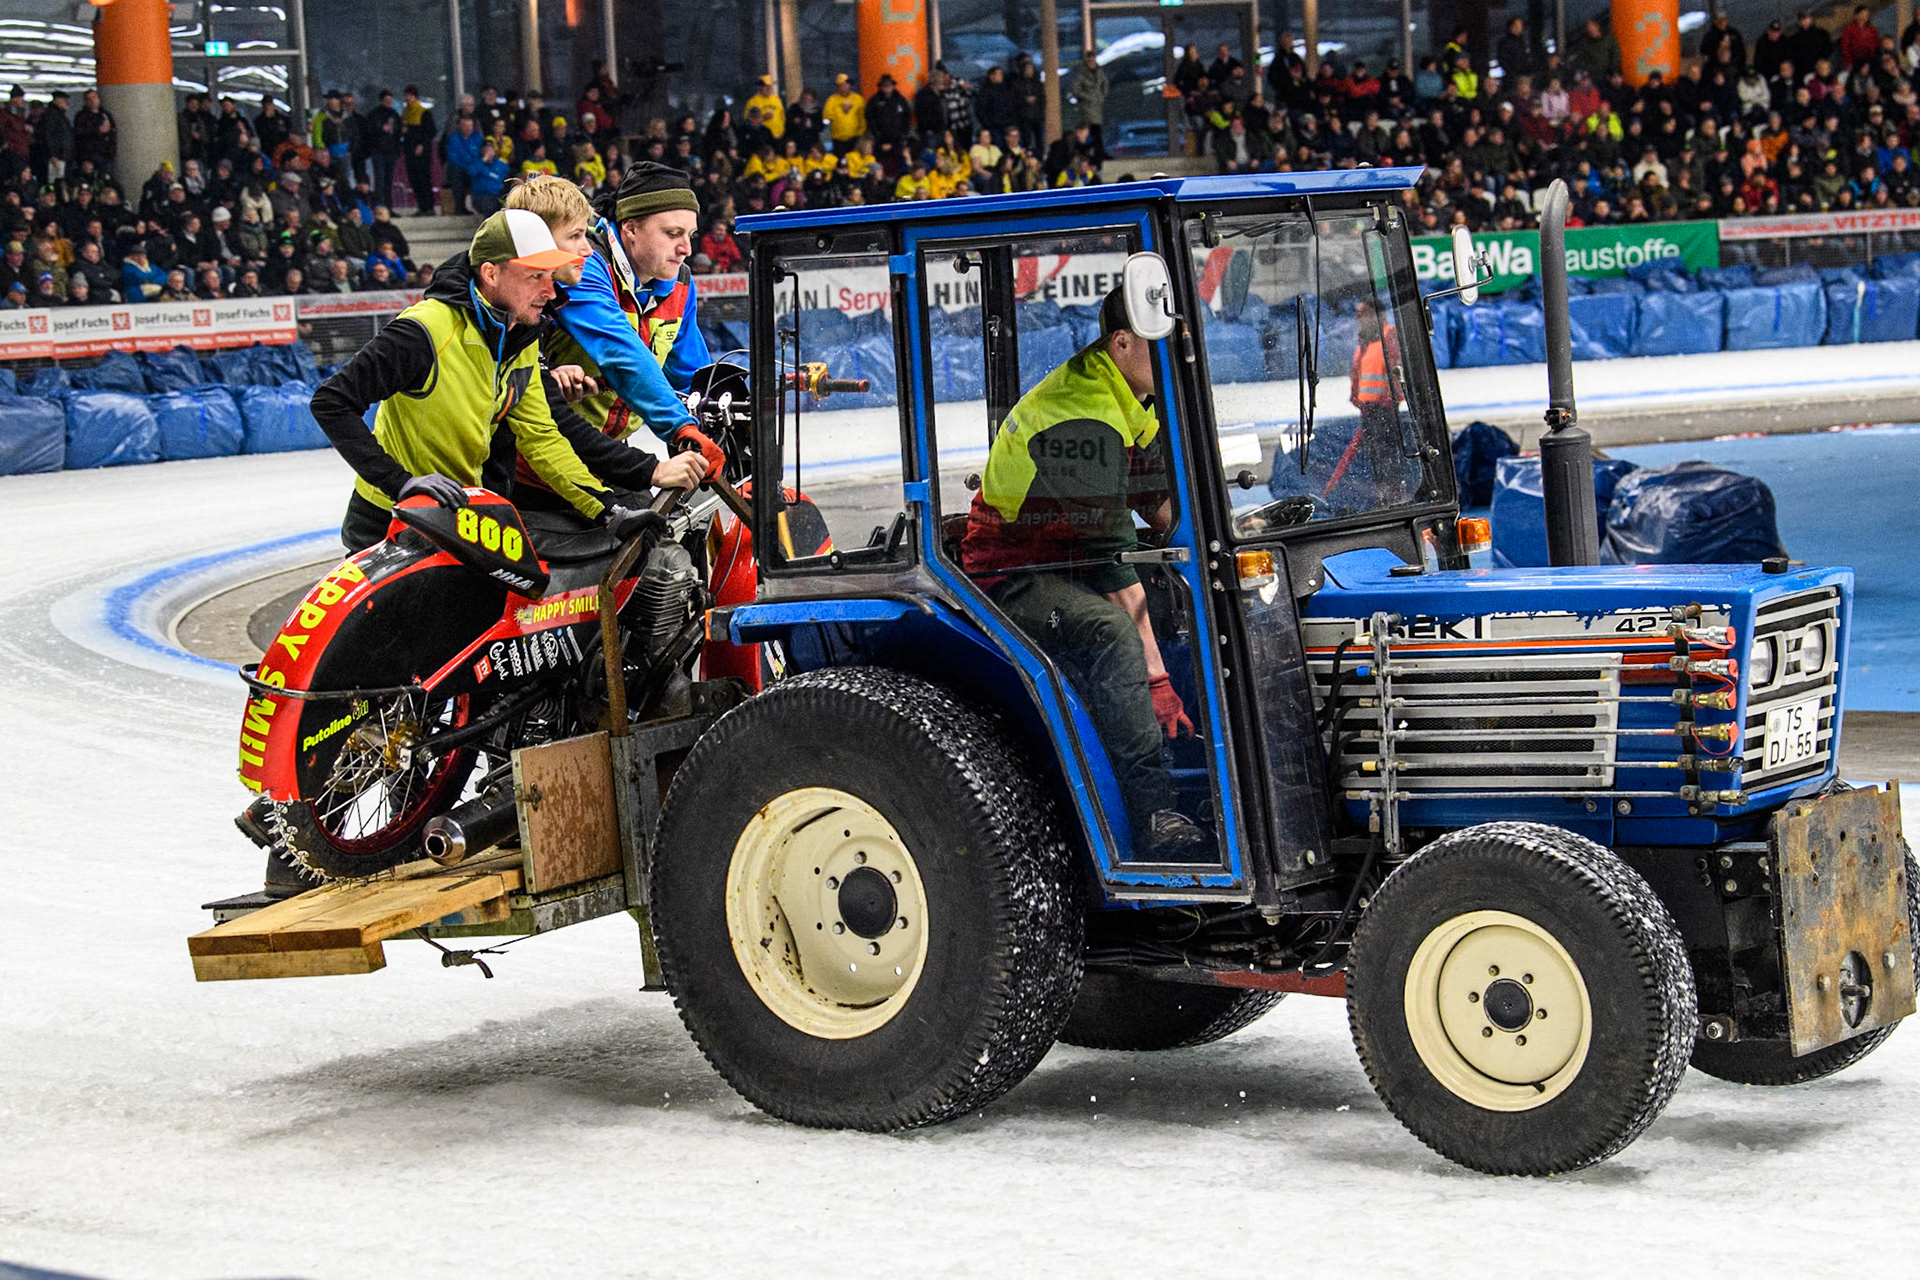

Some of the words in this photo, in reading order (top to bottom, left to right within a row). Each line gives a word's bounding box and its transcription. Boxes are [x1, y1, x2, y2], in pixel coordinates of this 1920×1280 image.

[1833, 213, 1920, 230] VITZTH
[1411, 240, 1533, 280] BaWa
[1565, 238, 1680, 271] austoffe
[457, 507, 523, 562] 800
[533, 600, 566, 623] HAPPY
[303, 714, 352, 752] Putoline
[1786, 706, 1803, 733] TS
[1770, 737, 1788, 766] DJ
[1796, 731, 1812, 757] 55
